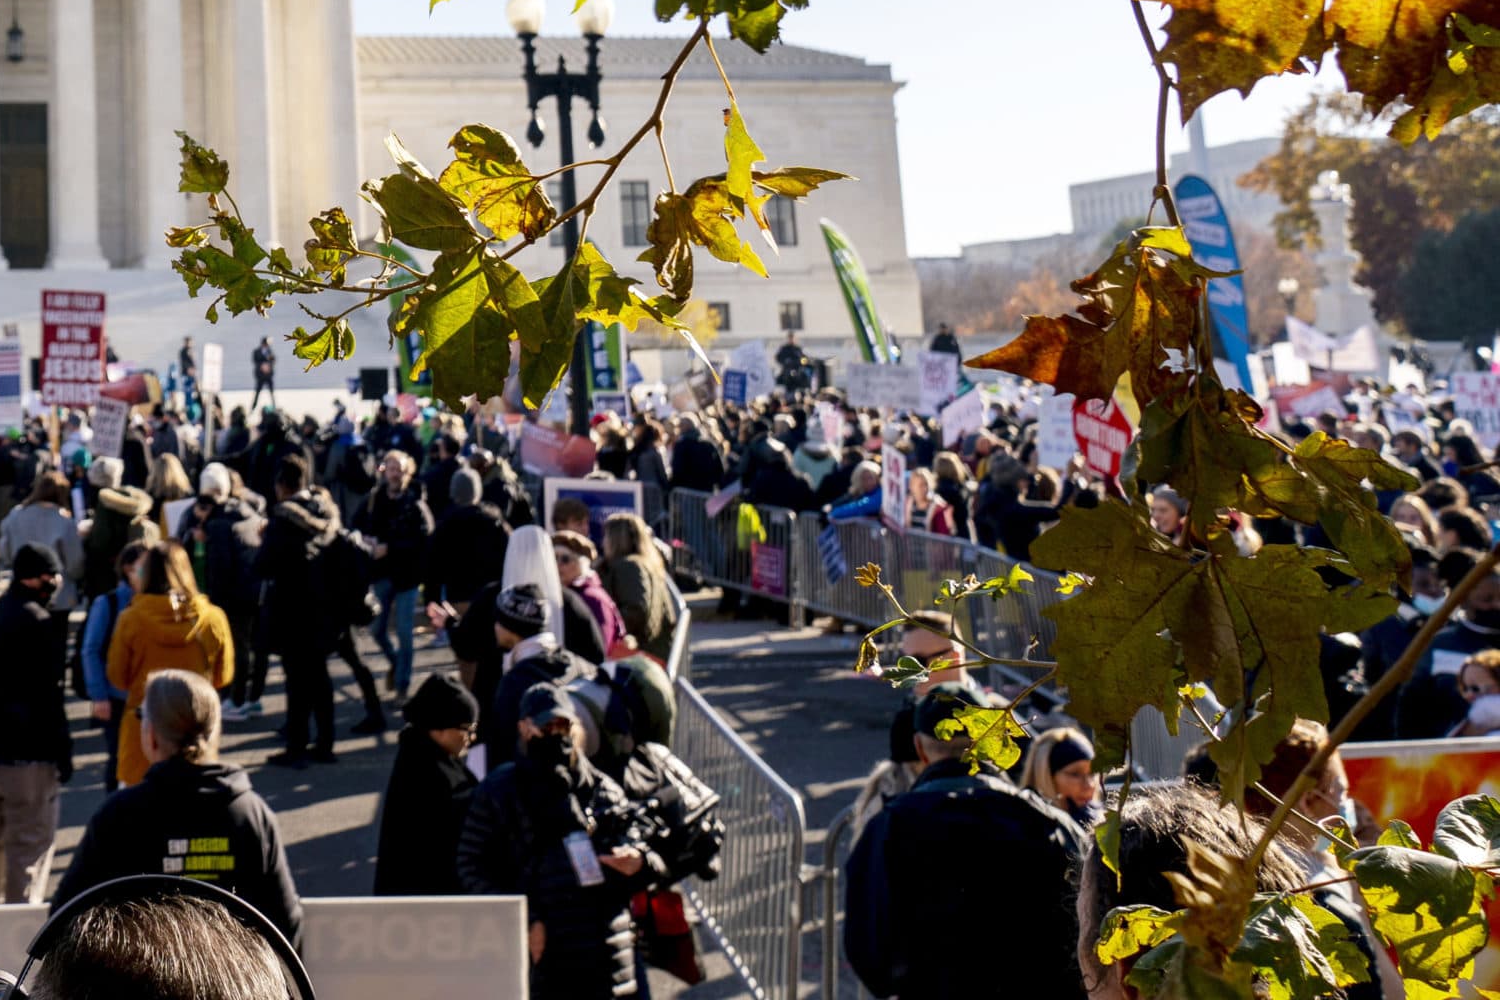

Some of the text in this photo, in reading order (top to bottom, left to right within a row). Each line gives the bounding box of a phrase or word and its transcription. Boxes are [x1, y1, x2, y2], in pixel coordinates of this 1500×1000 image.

[44, 359, 102, 380] JESUS
[167, 838, 188, 855] END
[162, 855, 235, 873] END ABORTION
